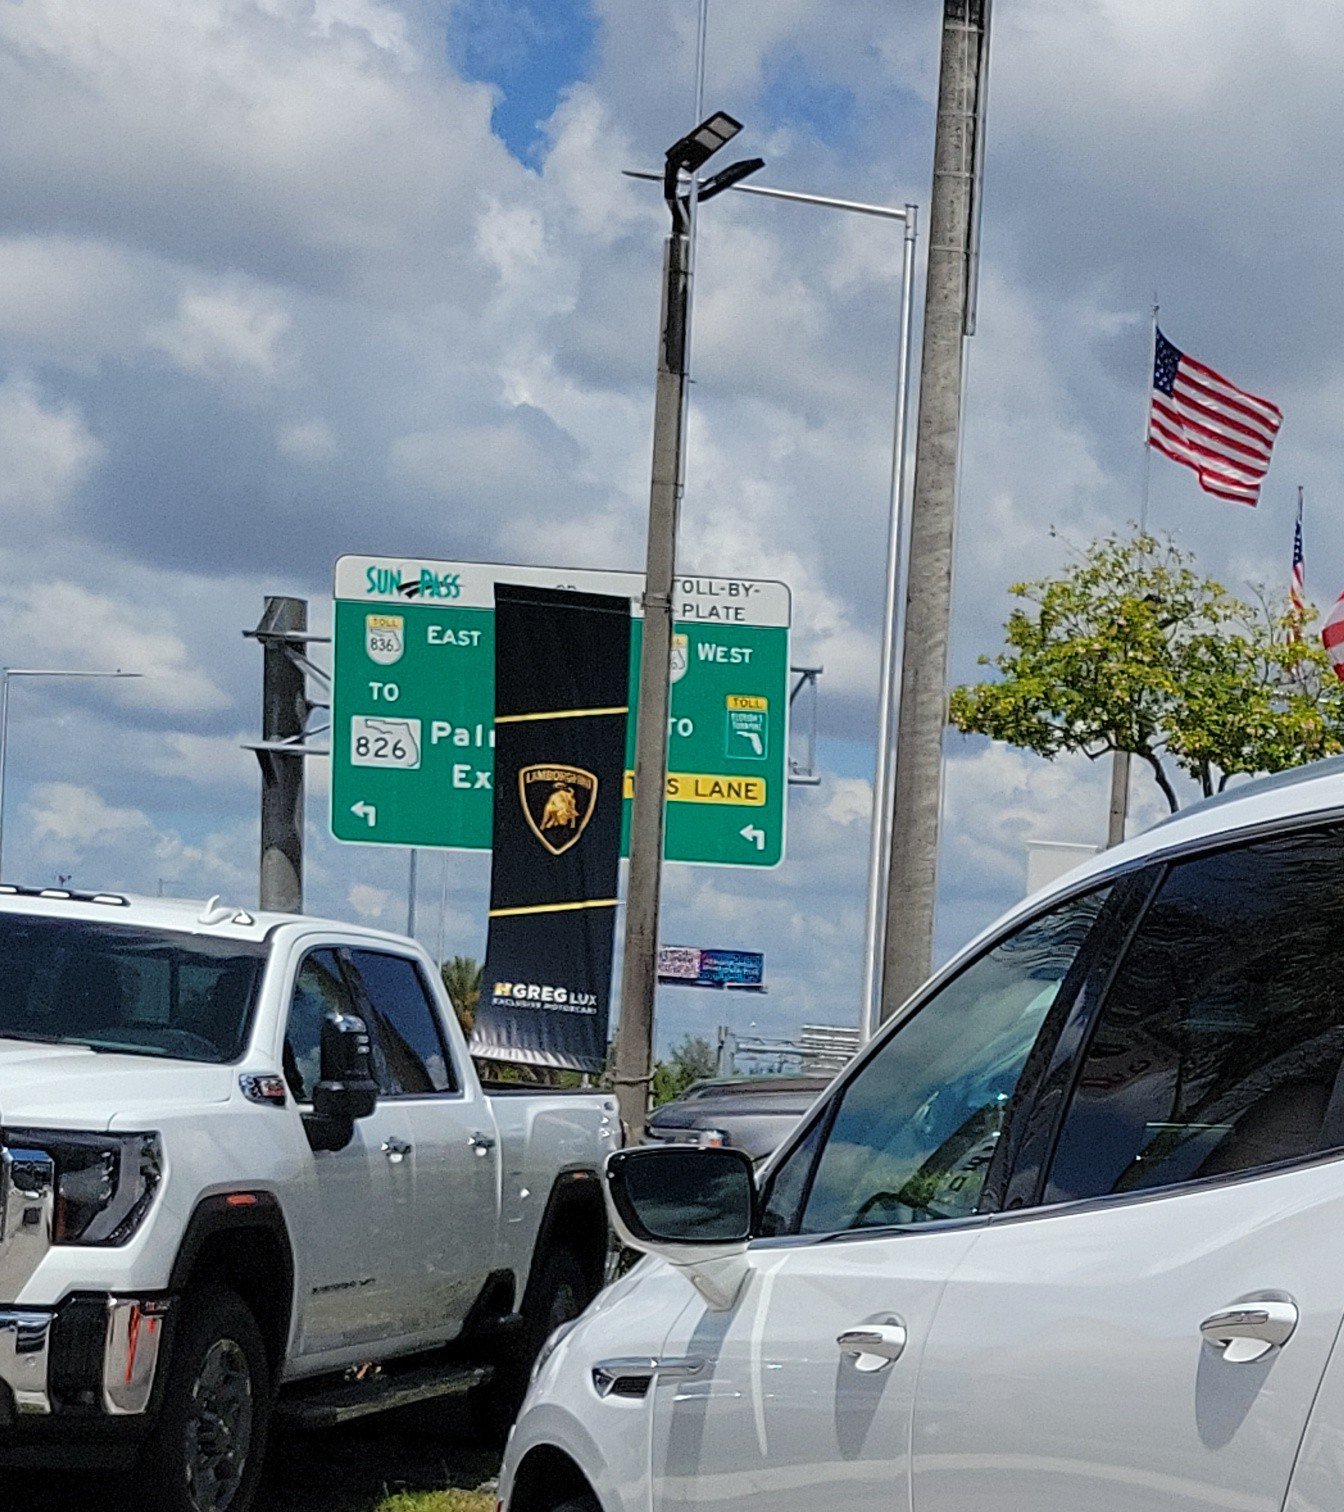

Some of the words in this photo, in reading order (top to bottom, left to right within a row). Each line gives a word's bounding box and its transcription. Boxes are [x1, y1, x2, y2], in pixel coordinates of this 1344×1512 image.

[682, 603, 746, 622] PLATE
[370, 638, 394, 652] 836
[427, 625, 483, 647] EAST
[697, 643, 753, 664] WEST
[369, 681, 400, 702] TO
[733, 697, 763, 710] TOLL
[356, 736, 406, 760] 826
[694, 778, 758, 800] LANE
[569, 992, 598, 1006] LUX
